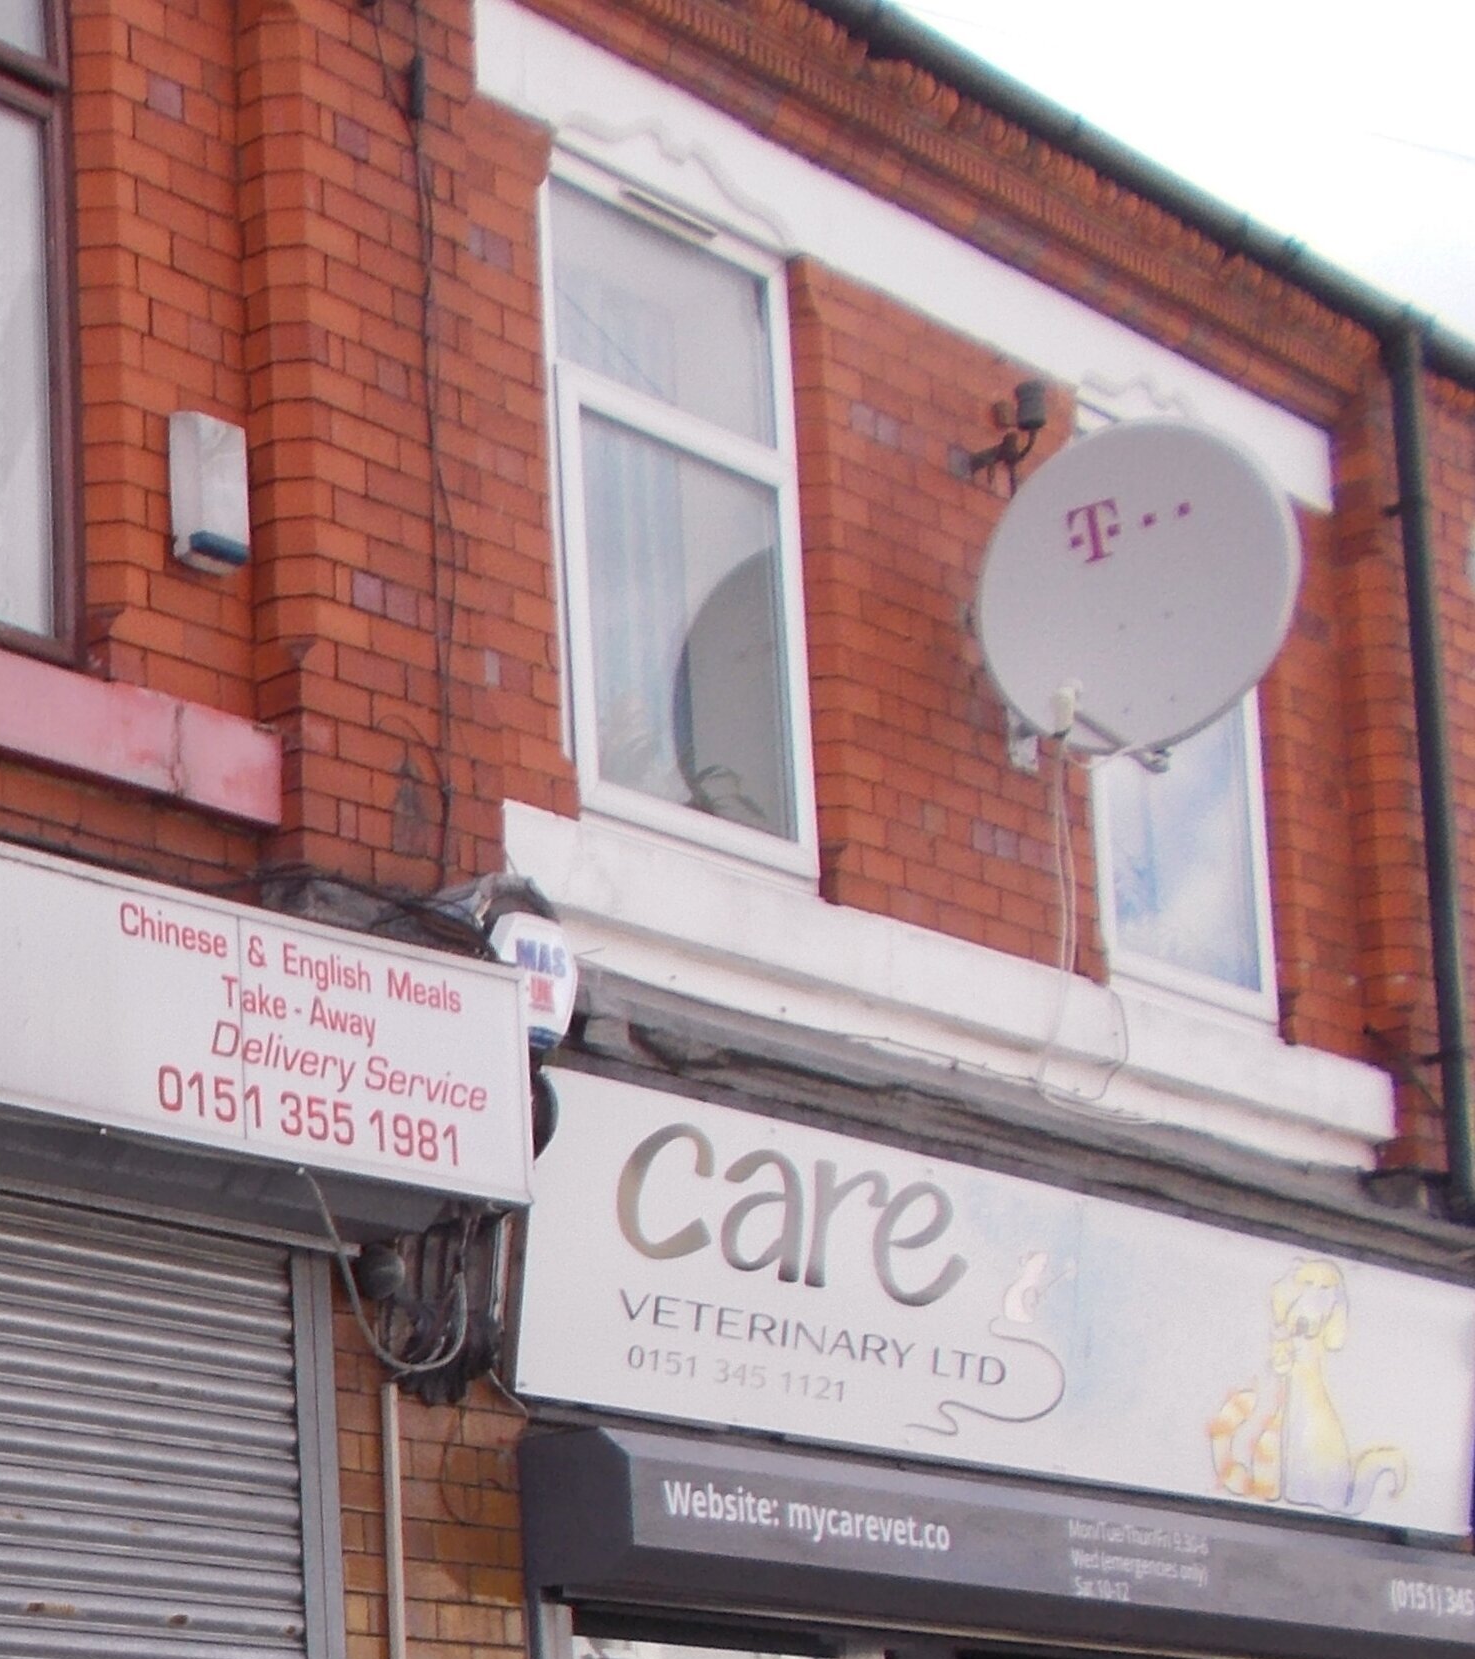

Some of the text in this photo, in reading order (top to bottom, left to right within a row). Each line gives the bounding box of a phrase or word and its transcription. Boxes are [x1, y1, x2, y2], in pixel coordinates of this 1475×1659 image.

[119, 902, 462, 1014] Chinese & English Meals
[221, 975, 287, 1020] Take
[309, 996, 376, 1047] Away
[211, 1019, 488, 1112] Delivery Service
[158, 1065, 459, 1167] 0151 355 1981
[616, 1122, 969, 1307] care
[619, 1288, 1007, 1386] VETERINARY LTD
[627, 1344, 845, 1402] 0151 345 1121
[663, 1480, 951, 1551] Website: mycarevet.co
